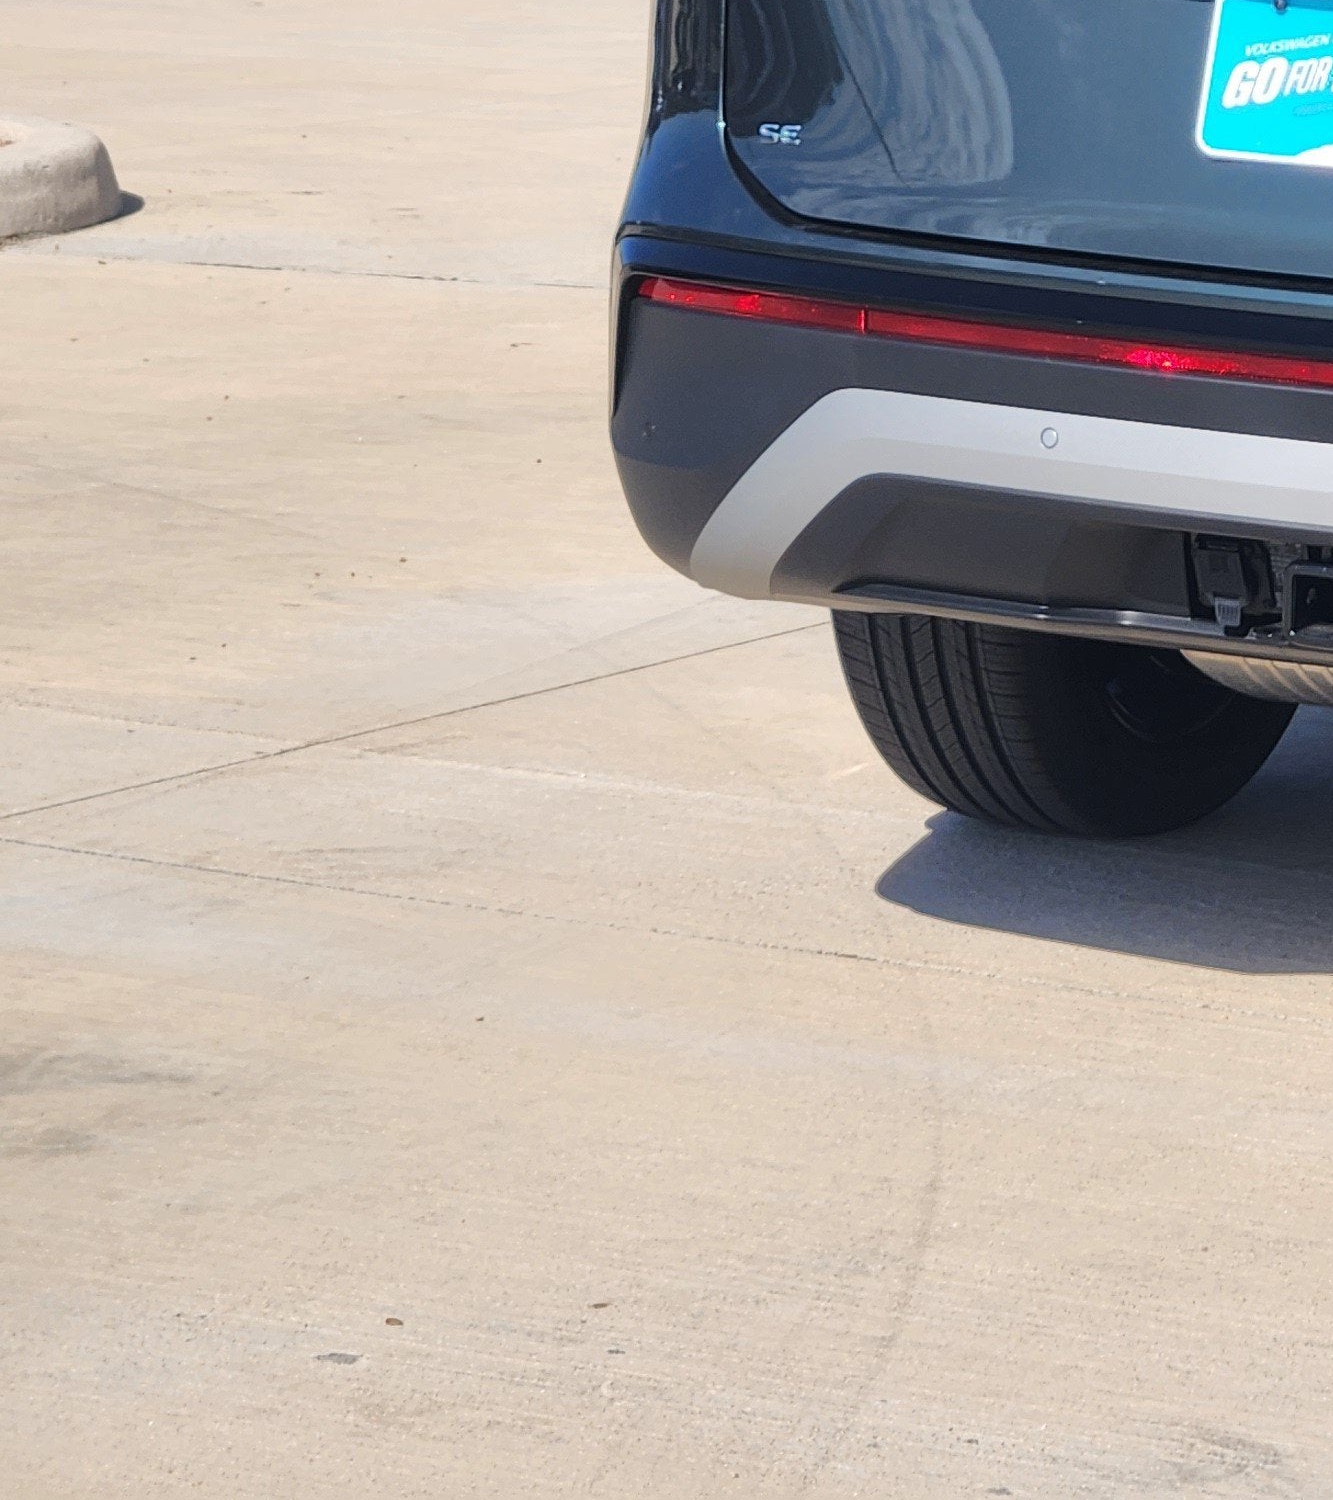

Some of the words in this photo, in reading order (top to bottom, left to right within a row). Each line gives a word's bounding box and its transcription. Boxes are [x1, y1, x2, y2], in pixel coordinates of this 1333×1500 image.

[1245, 34, 1330, 57] VOLKSWAGEN
[1221, 56, 1289, 109] GO
[1283, 55, 1333, 96] FOR
[758, 123, 802, 146] SE
